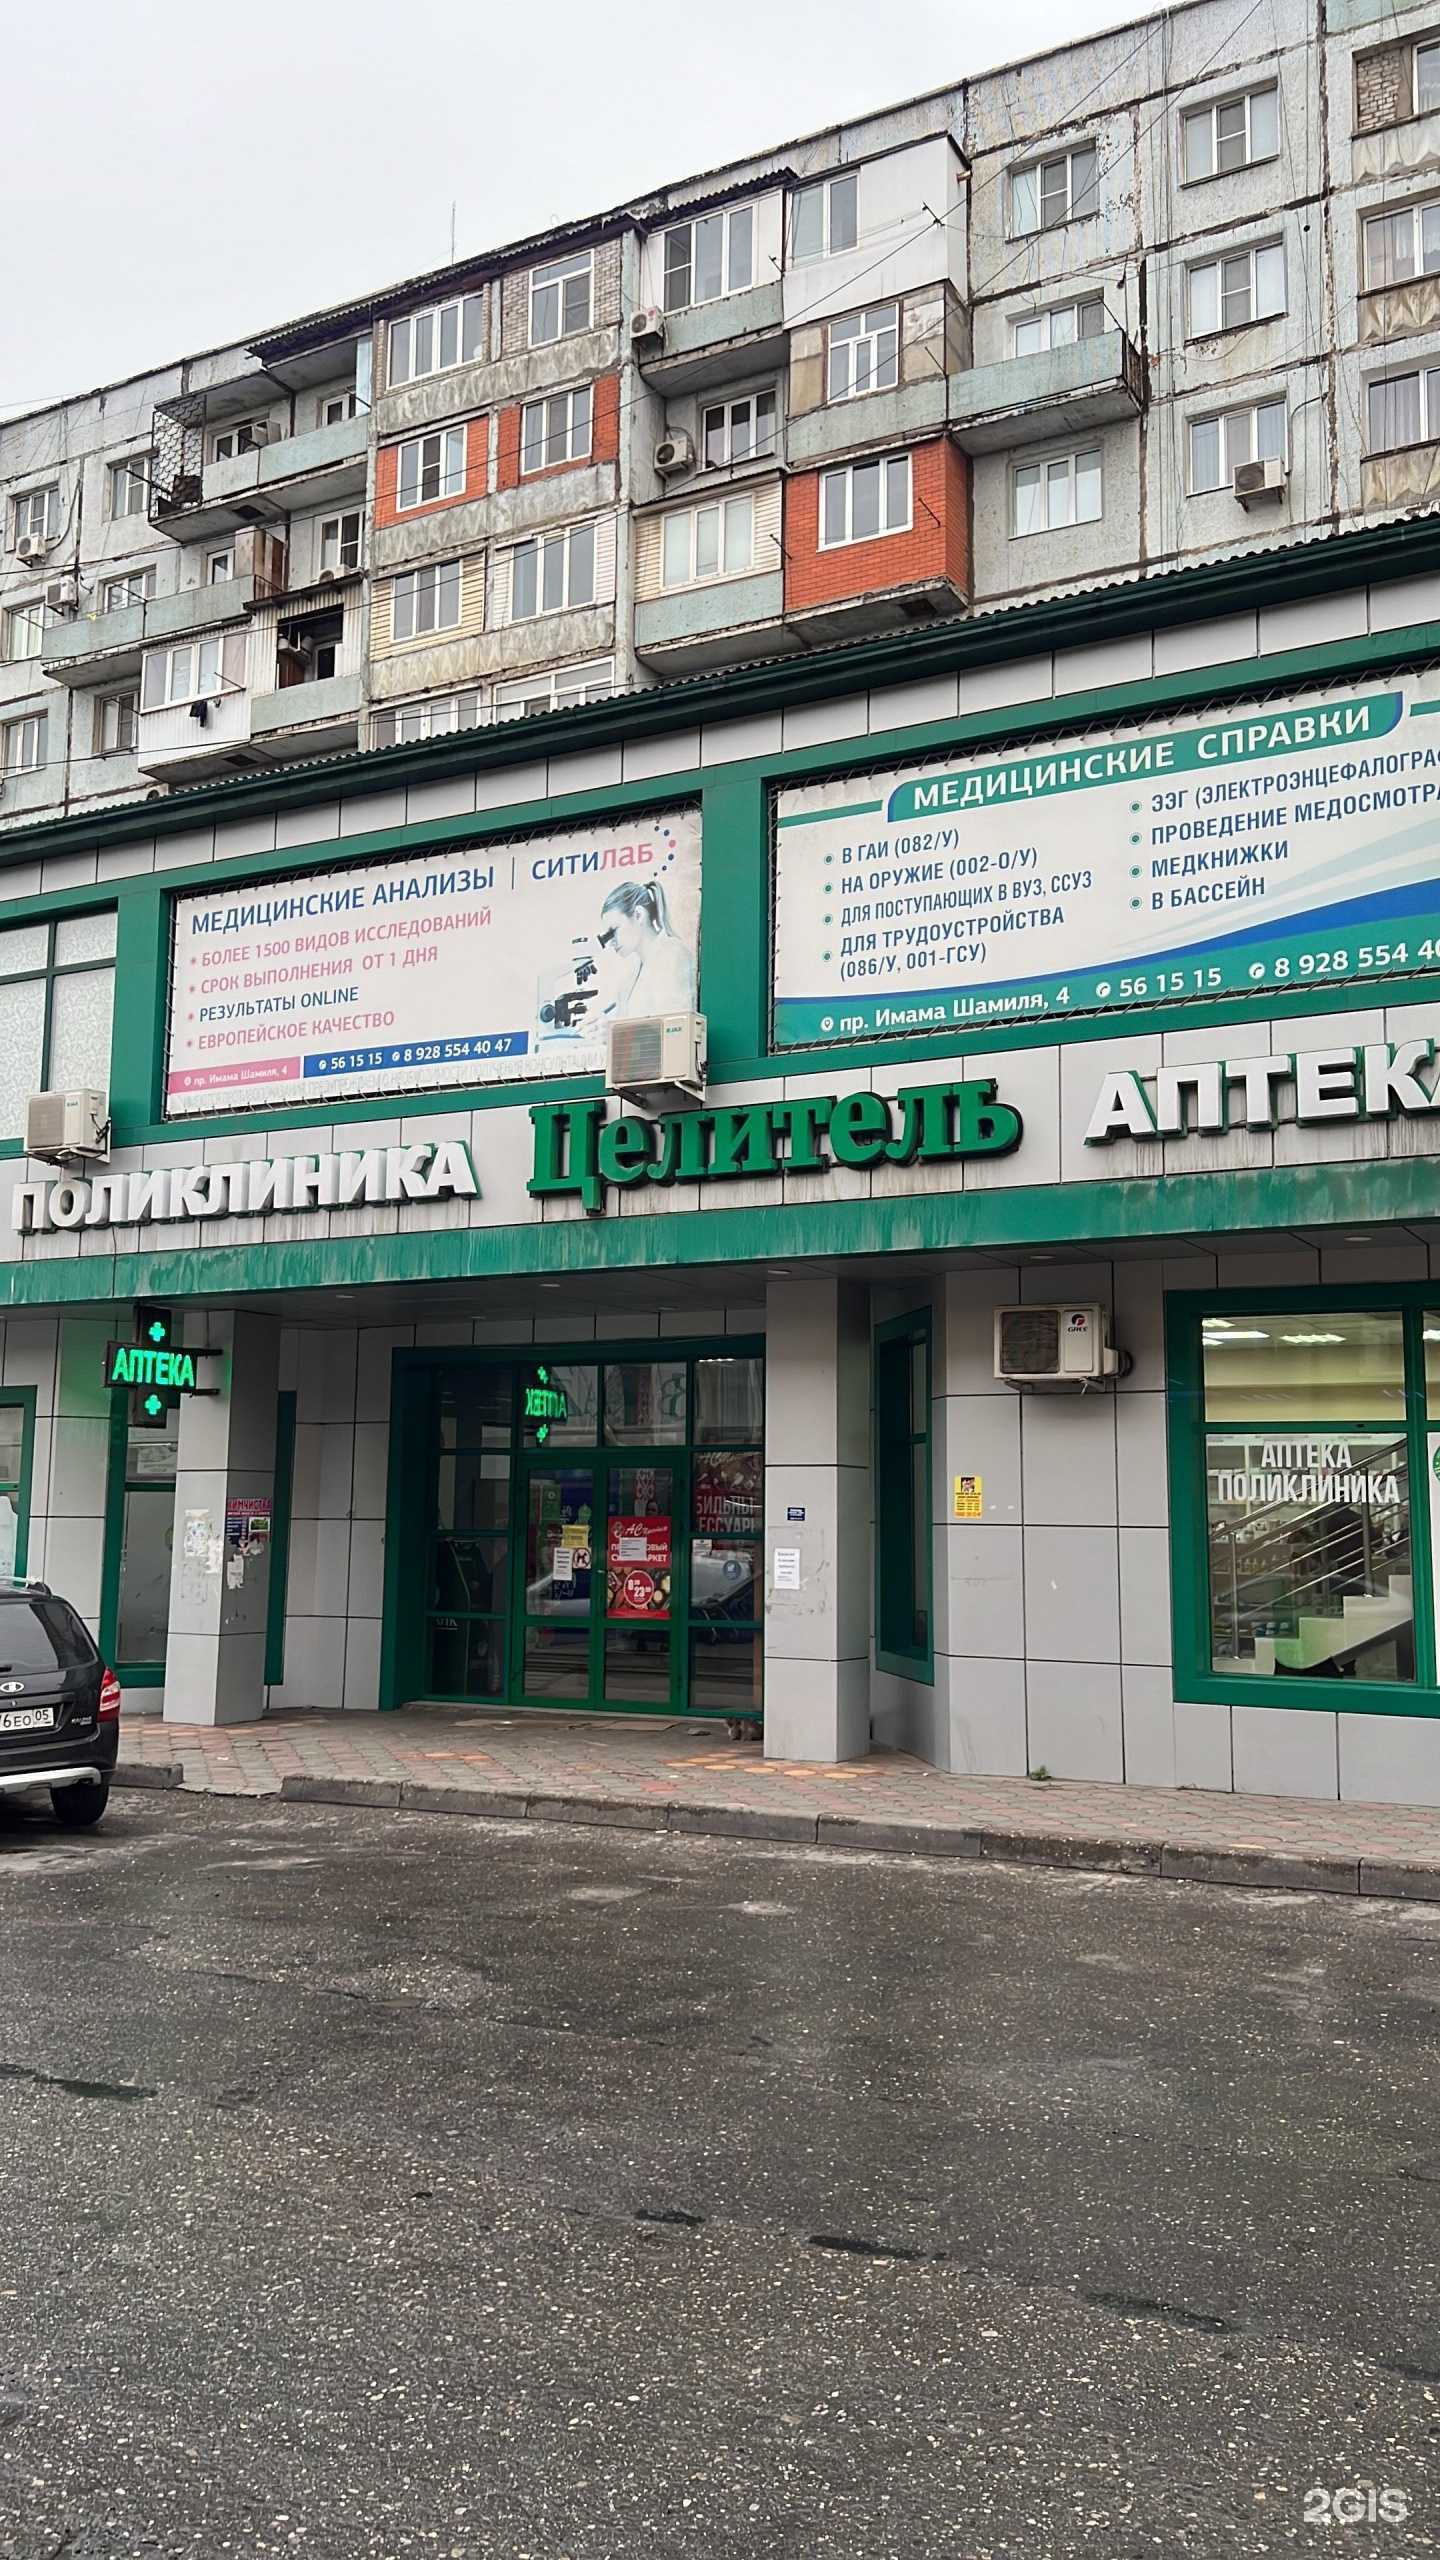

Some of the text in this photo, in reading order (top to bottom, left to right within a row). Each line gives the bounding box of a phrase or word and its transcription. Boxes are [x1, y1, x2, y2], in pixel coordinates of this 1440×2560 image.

[914, 705, 1370, 810] МЕДИЦИНСКИЕ СПРАВКИ
[1152, 748, 1440, 813] ЭЭГ (ЭЛЕКТРОЭНЦЕФАЛОГРА
[1152, 808, 1287, 845] ПРОВЕДЕНИЕ
[842, 828, 960, 864] В ГАИ (082/У)
[1152, 840, 1289, 878] МЕДКНИЖКИ
[841, 876, 863, 894] НА
[869, 863, 944, 890] ОРУЖИЕ
[1152, 876, 1266, 910] В БАССЕЙН
[192, 866, 494, 935] МЕДИЦИНСКИЕ АНАЛИЗЫ
[841, 871, 1093, 928] ДЛЯ ПОСТУПАЮЩИХ В ВУЗ, ССУЗ
[202, 906, 491, 966] БОЛЕЕ 1500 ВИДОВ ИССЛЕДОВАНИЙ
[841, 906, 1065, 957] ДЛЯ ТРУДОУСТРОЙСТВА
[201, 946, 438, 994] СРОК ВЫПОЛНЕНИЯ ОТ 1 ДНЯ
[840, 943, 987, 982] (086/У, 001-ГСУ)
[1274, 958, 1290, 977] 8
[1299, 950, 1348, 975] 928
[1358, 943, 1408, 968] 554
[1119, 968, 1222, 997] 56 15 15
[200, 987, 359, 1022] РЕЗУЛЬТАТЫ ONLINE
[840, 987, 1070, 1035] пр. Имама Шамиля, 4
[199, 1011, 394, 1050] ЕВРОПЕЙСКОЕ КАЧЕСТВО
[331, 1053, 382, 1070] 56 15 15
[404, 1038, 513, 1062] 8 928 554 40 47
[209, 1071, 239, 1083] Имама
[241, 1068, 280, 1081] Шамиля,
[281, 1066, 288, 1075] 4
[1083, 1038, 1440, 1147] АПТЕК
[527, 1079, 1024, 1216] Целитель
[11, 1140, 483, 1235] ПОЛИКЛИНИКА
[111, 1347, 195, 1387] АПТЕКА
[1261, 1441, 1351, 1468] АПТЕКА
[1218, 1474, 1400, 1503] ПОЛИКЛИНИКА
[35, 1709, 49, 1721] 05
